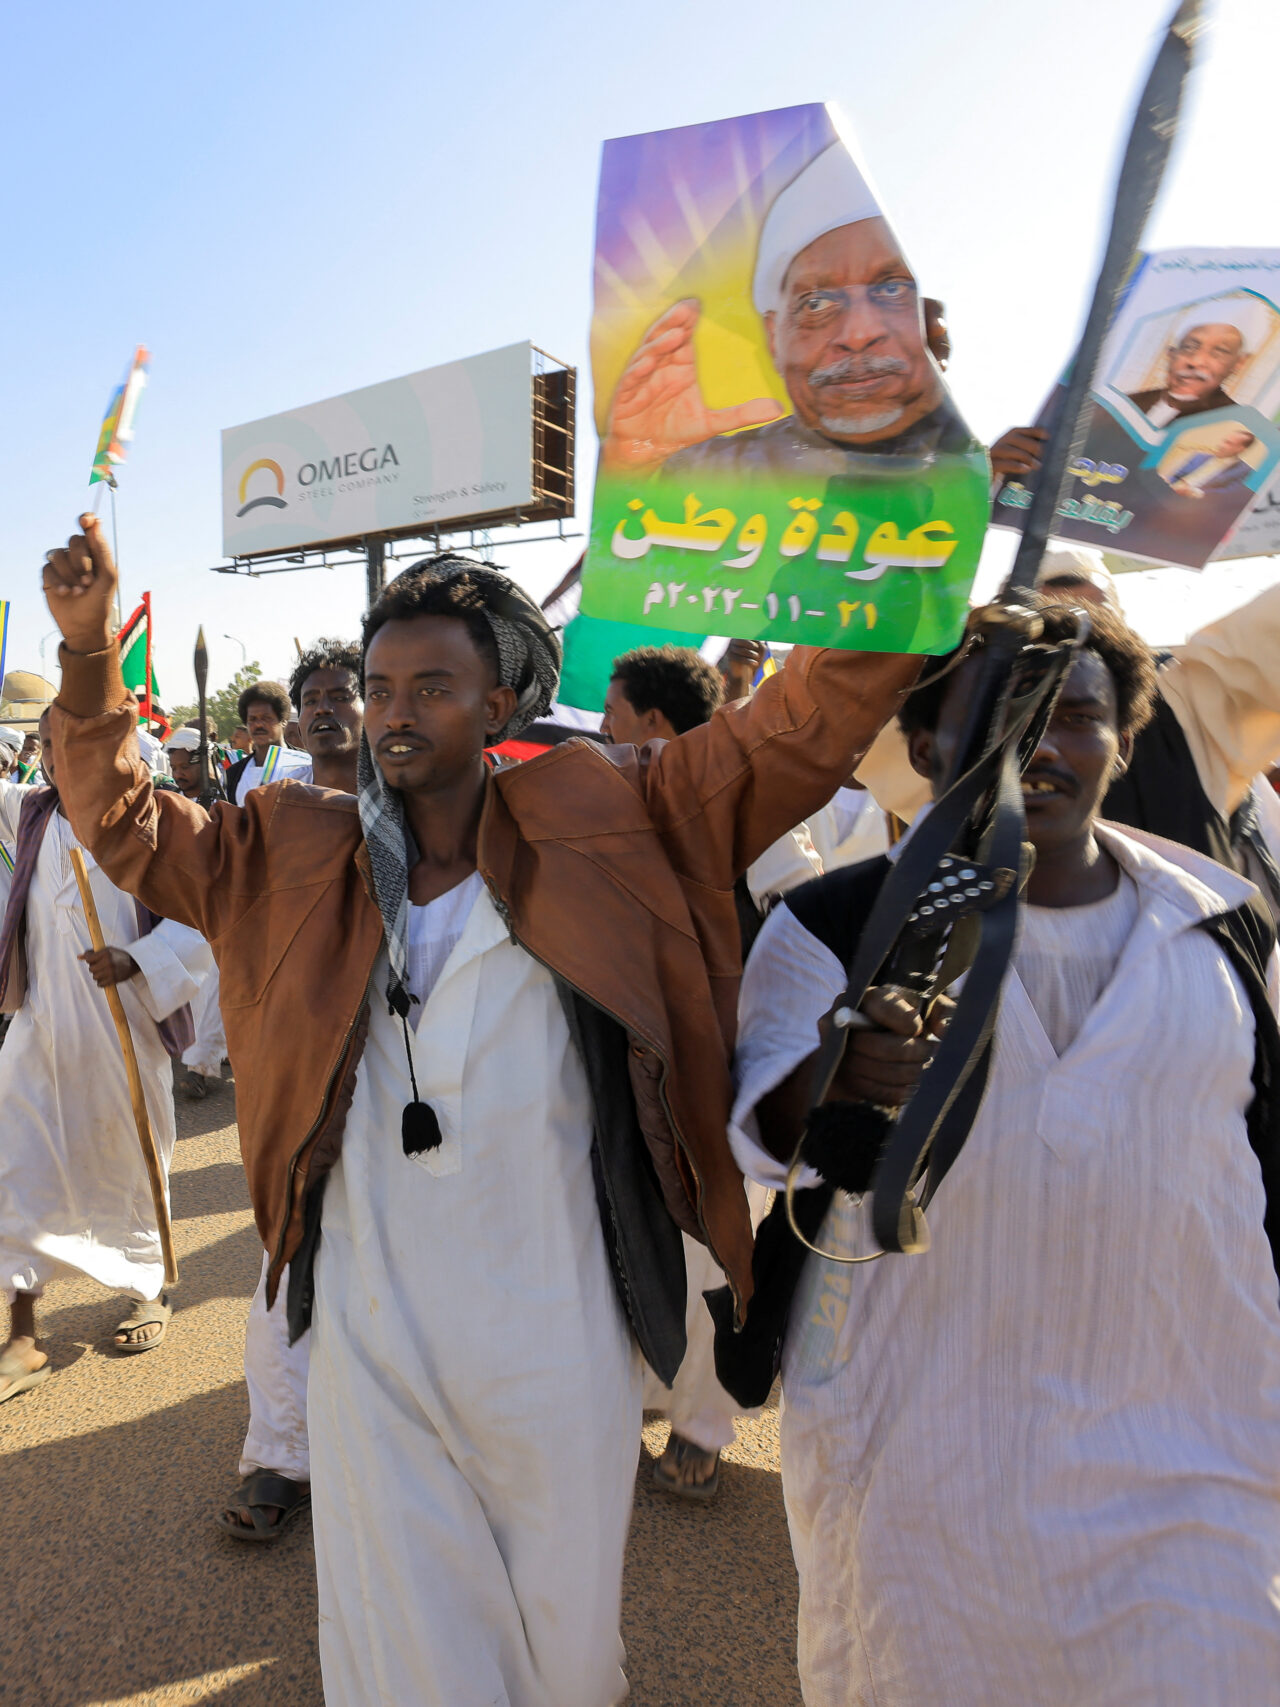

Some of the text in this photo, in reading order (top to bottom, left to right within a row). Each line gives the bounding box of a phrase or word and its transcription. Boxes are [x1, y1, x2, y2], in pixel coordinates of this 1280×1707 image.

[298, 443, 399, 486] OMEGA
[298, 472, 399, 502] STEEL COMPANY
[611, 492, 960, 581] عودة وطن
